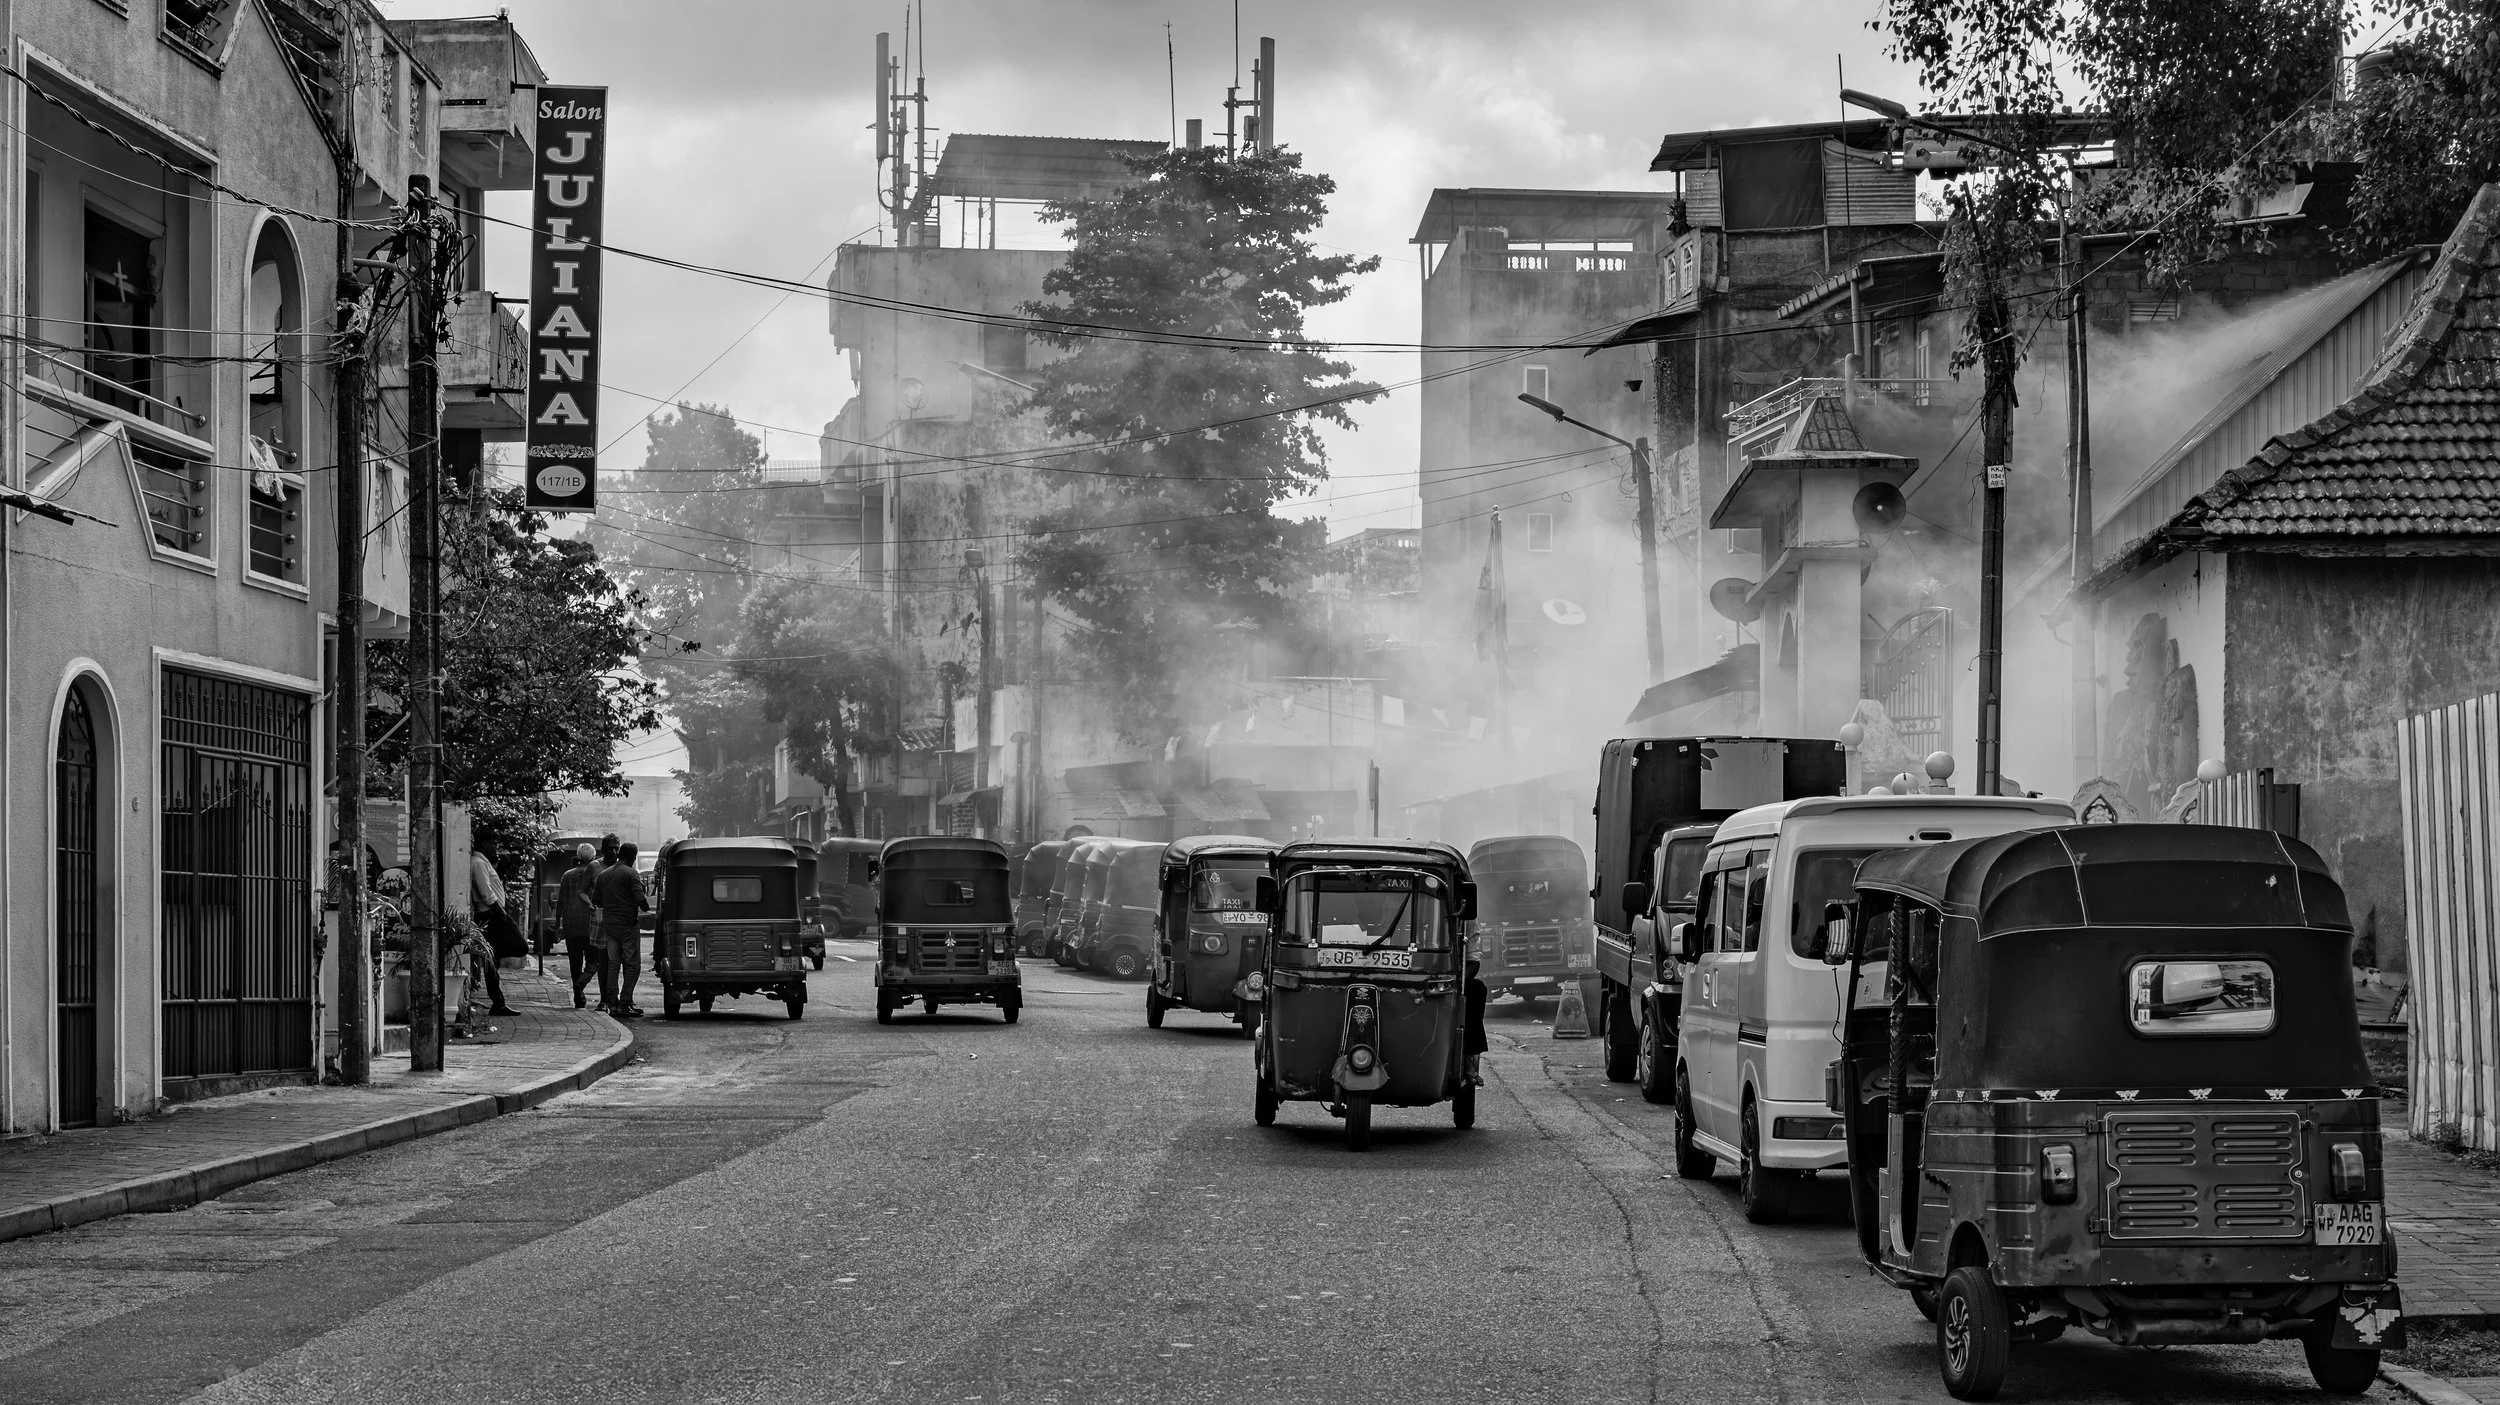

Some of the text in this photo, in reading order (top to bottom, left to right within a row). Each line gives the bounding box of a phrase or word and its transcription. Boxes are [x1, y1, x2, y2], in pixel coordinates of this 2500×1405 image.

[539, 100, 602, 120] Salon
[536, 131, 595, 425] JULIANA
[541, 476, 581, 487] 117/1B
[1387, 879, 1409, 888] TAXI
[1233, 913, 1246, 922] YO
[1257, 913, 1269, 922] 98
[1334, 951, 1354, 964] QB
[1372, 952, 1410, 968] 9535
[2318, 1204, 2373, 1231] WP AAG
[2336, 1225, 2374, 1243] 7929
